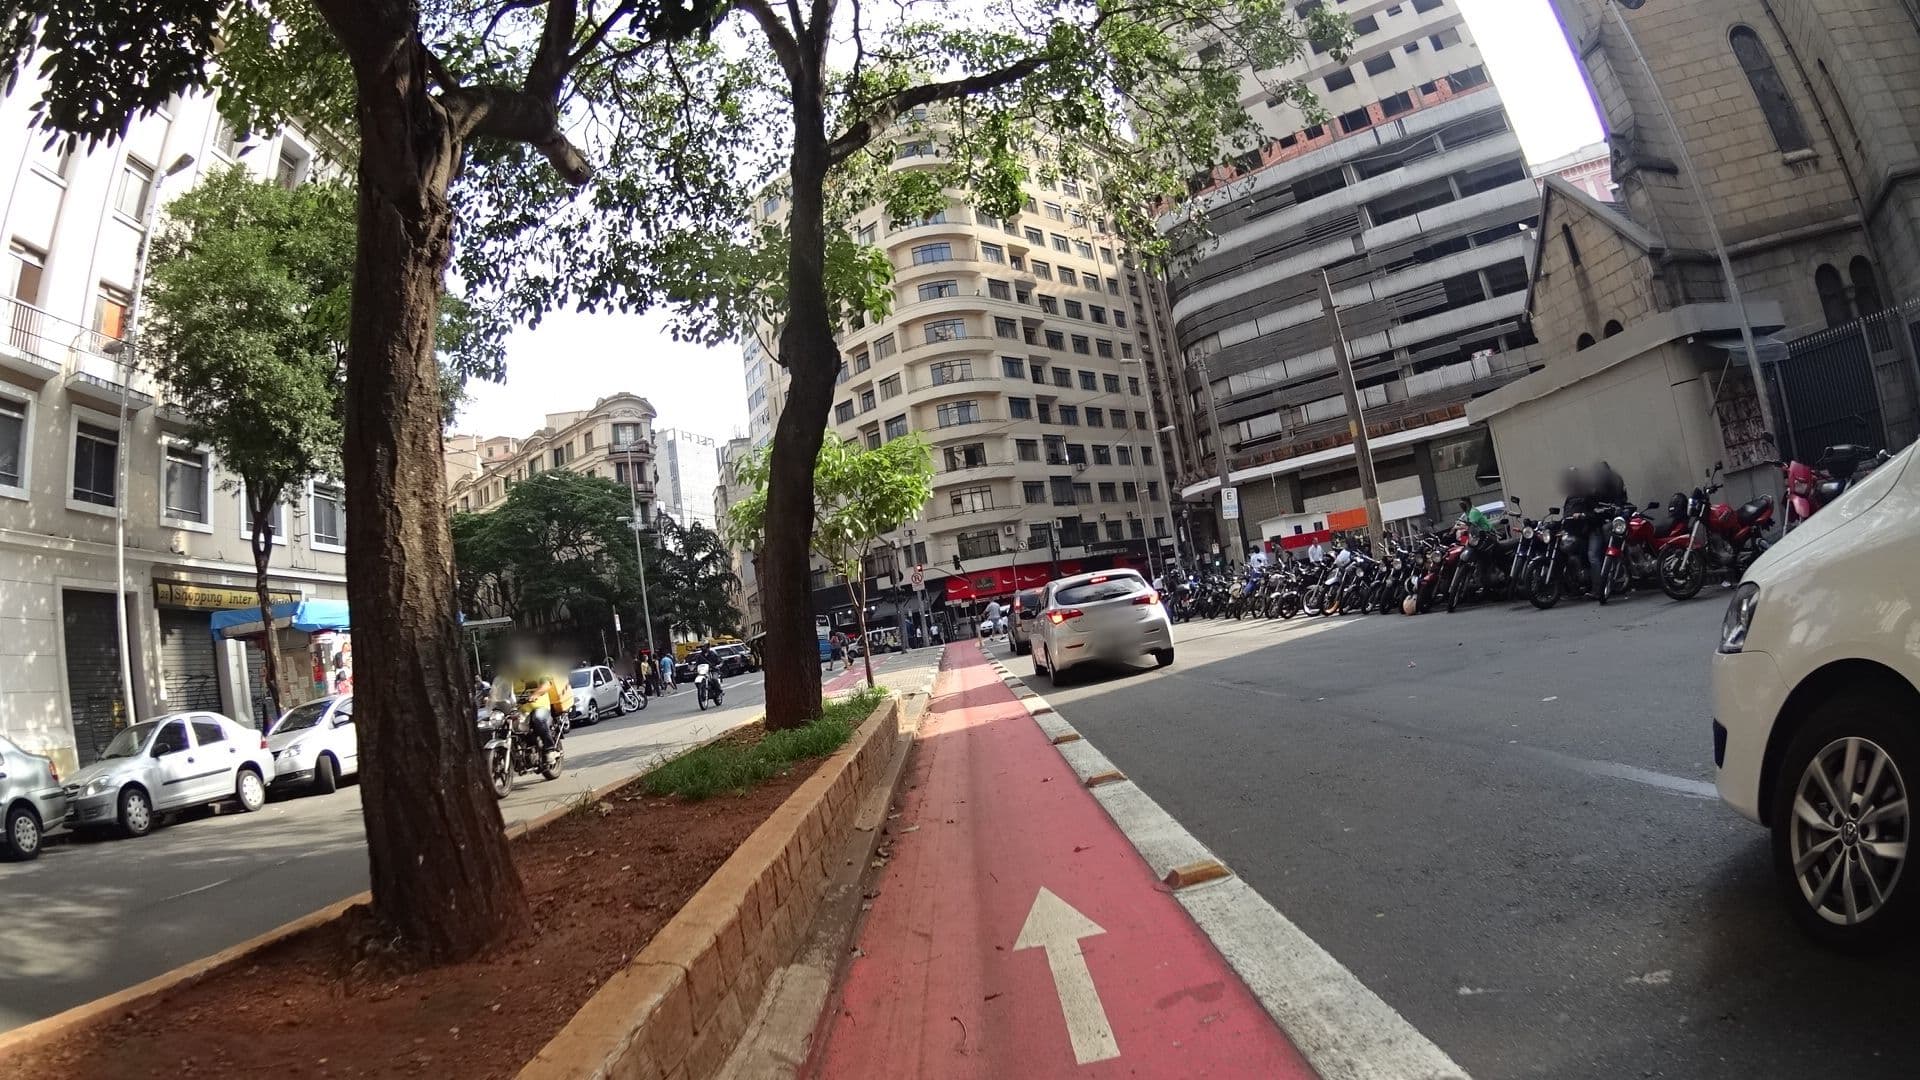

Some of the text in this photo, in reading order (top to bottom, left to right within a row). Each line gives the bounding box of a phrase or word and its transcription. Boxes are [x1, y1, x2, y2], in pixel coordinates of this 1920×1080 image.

[1226, 491, 1232, 500] E
[174, 587, 223, 606] Shopping
[229, 592, 252, 605] Inter
